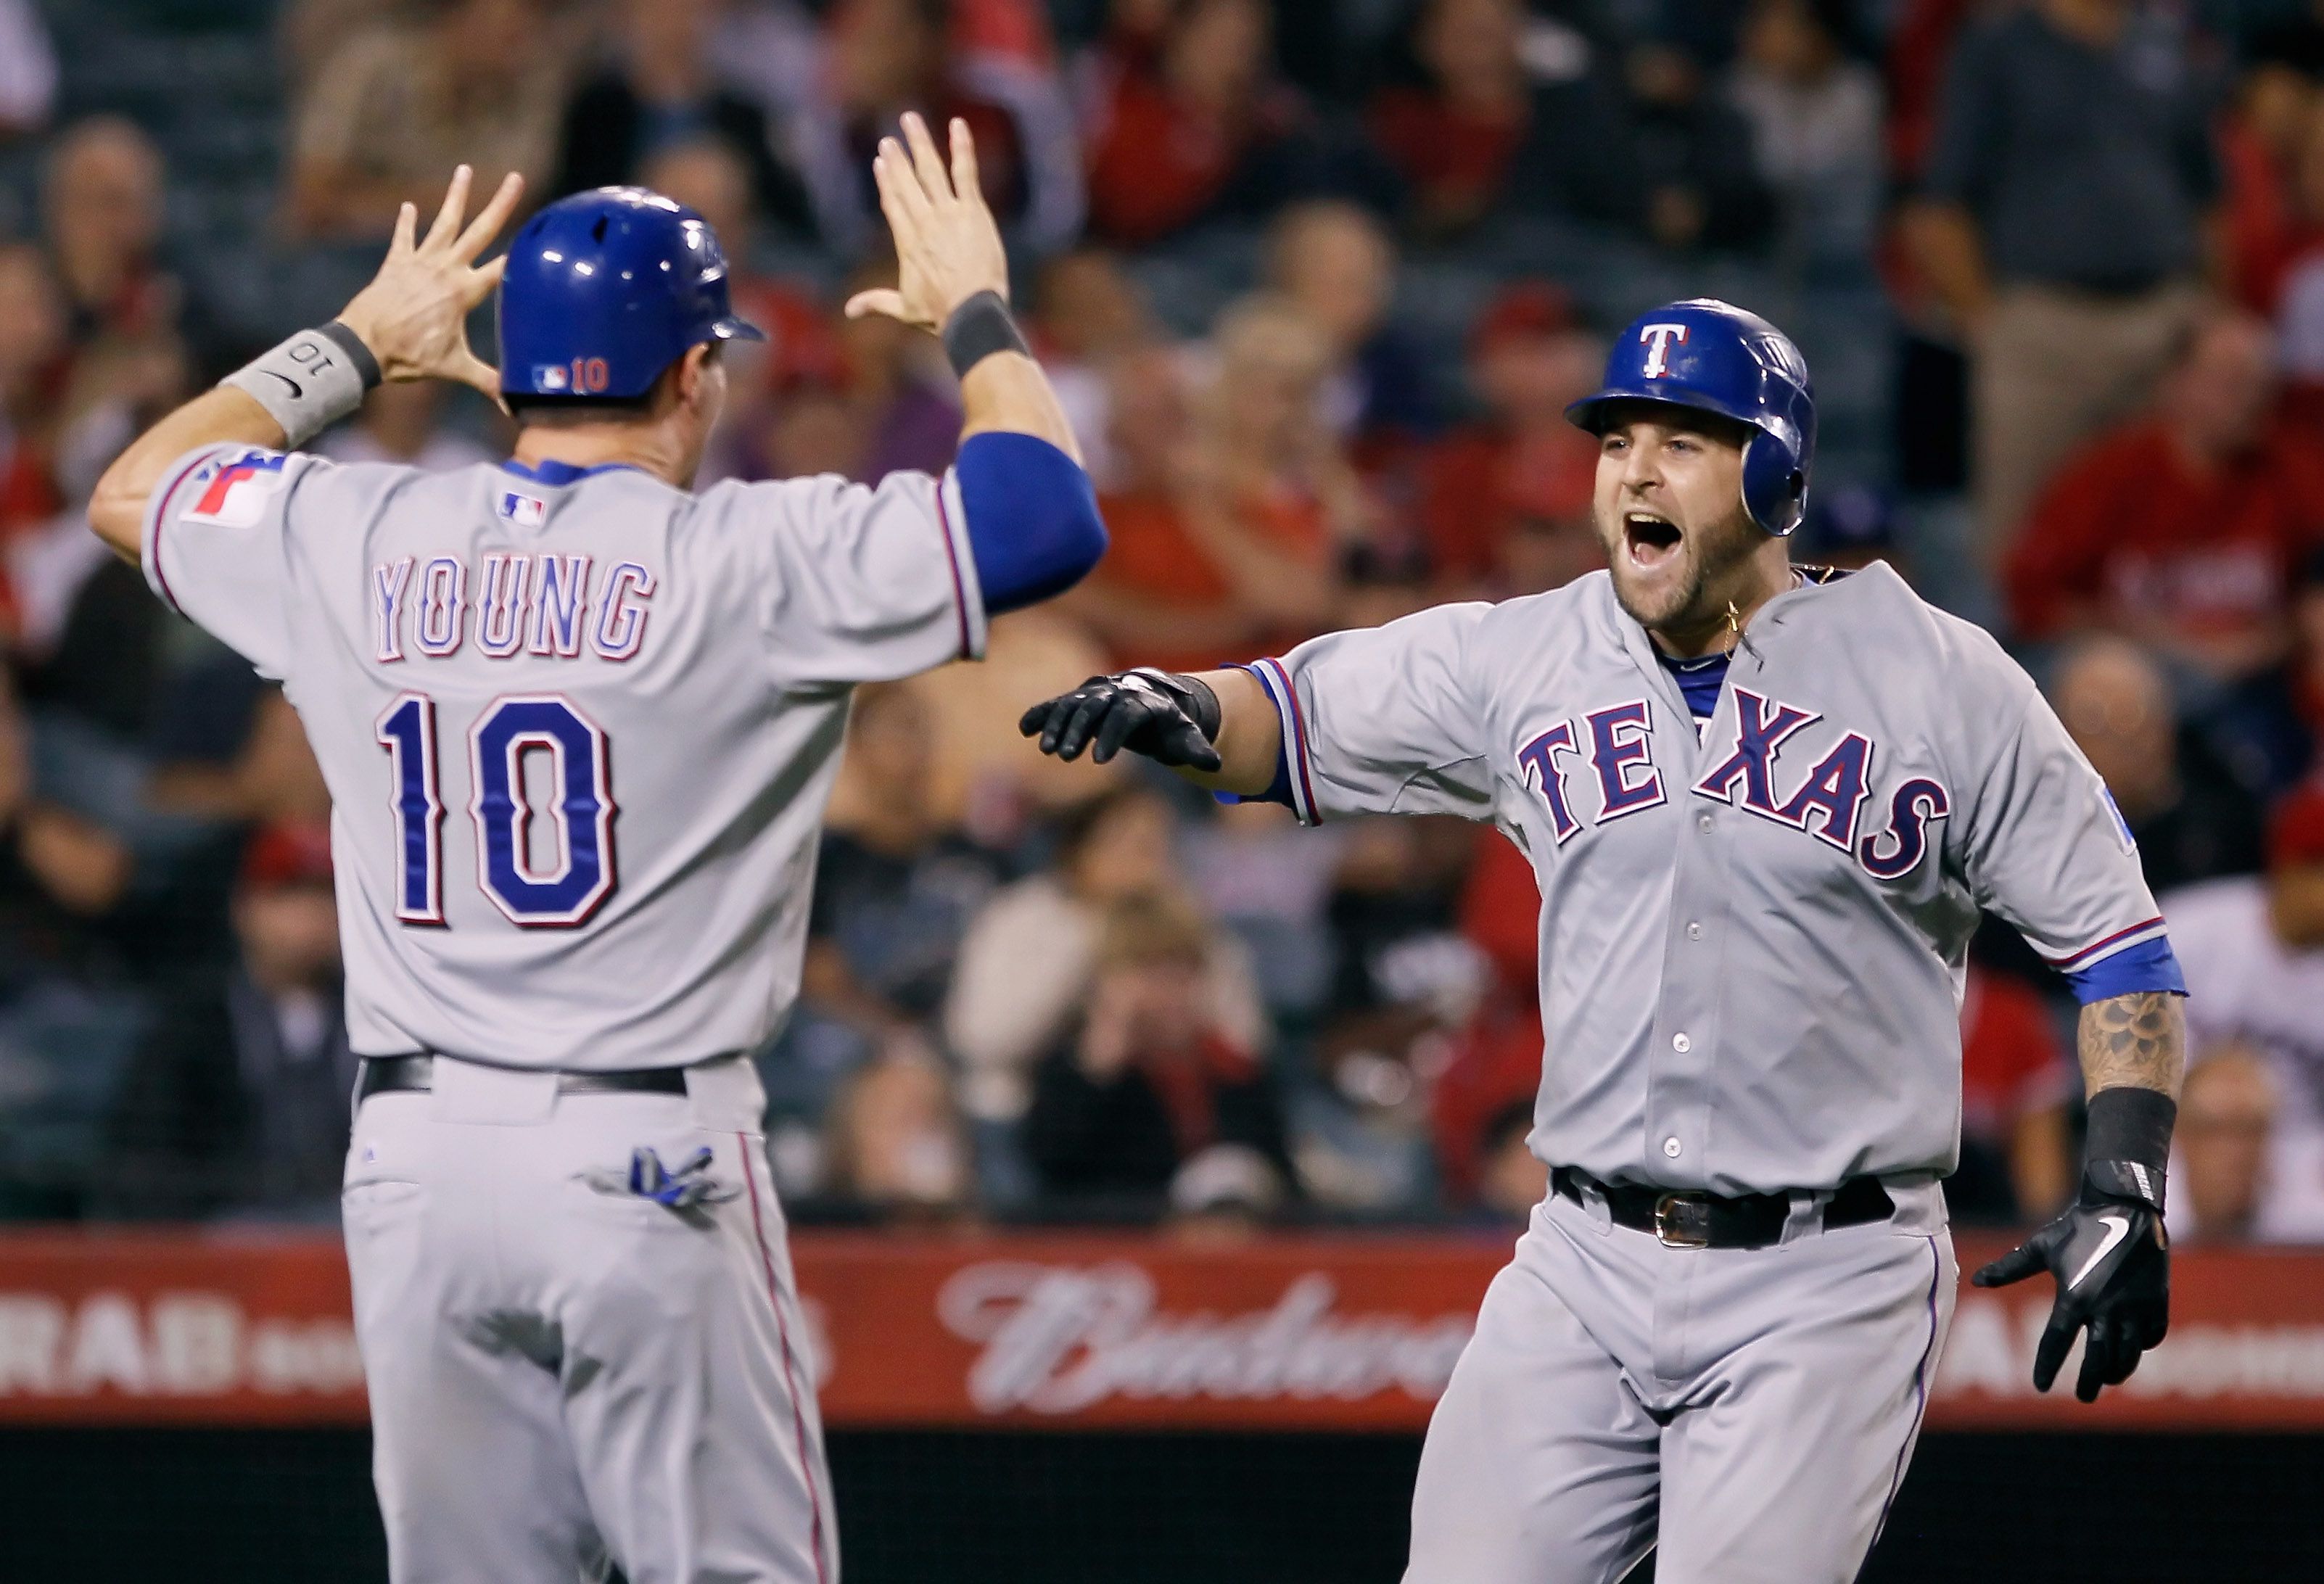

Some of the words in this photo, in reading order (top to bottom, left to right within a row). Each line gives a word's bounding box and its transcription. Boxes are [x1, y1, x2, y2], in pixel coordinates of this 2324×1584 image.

[289, 342, 333, 376] 10
[571, 357, 609, 395] 10
[1640, 323, 1690, 379] T
[371, 553, 657, 663] YOUNG
[374, 689, 620, 929] 10
[1516, 681, 1950, 880] TEXAS
